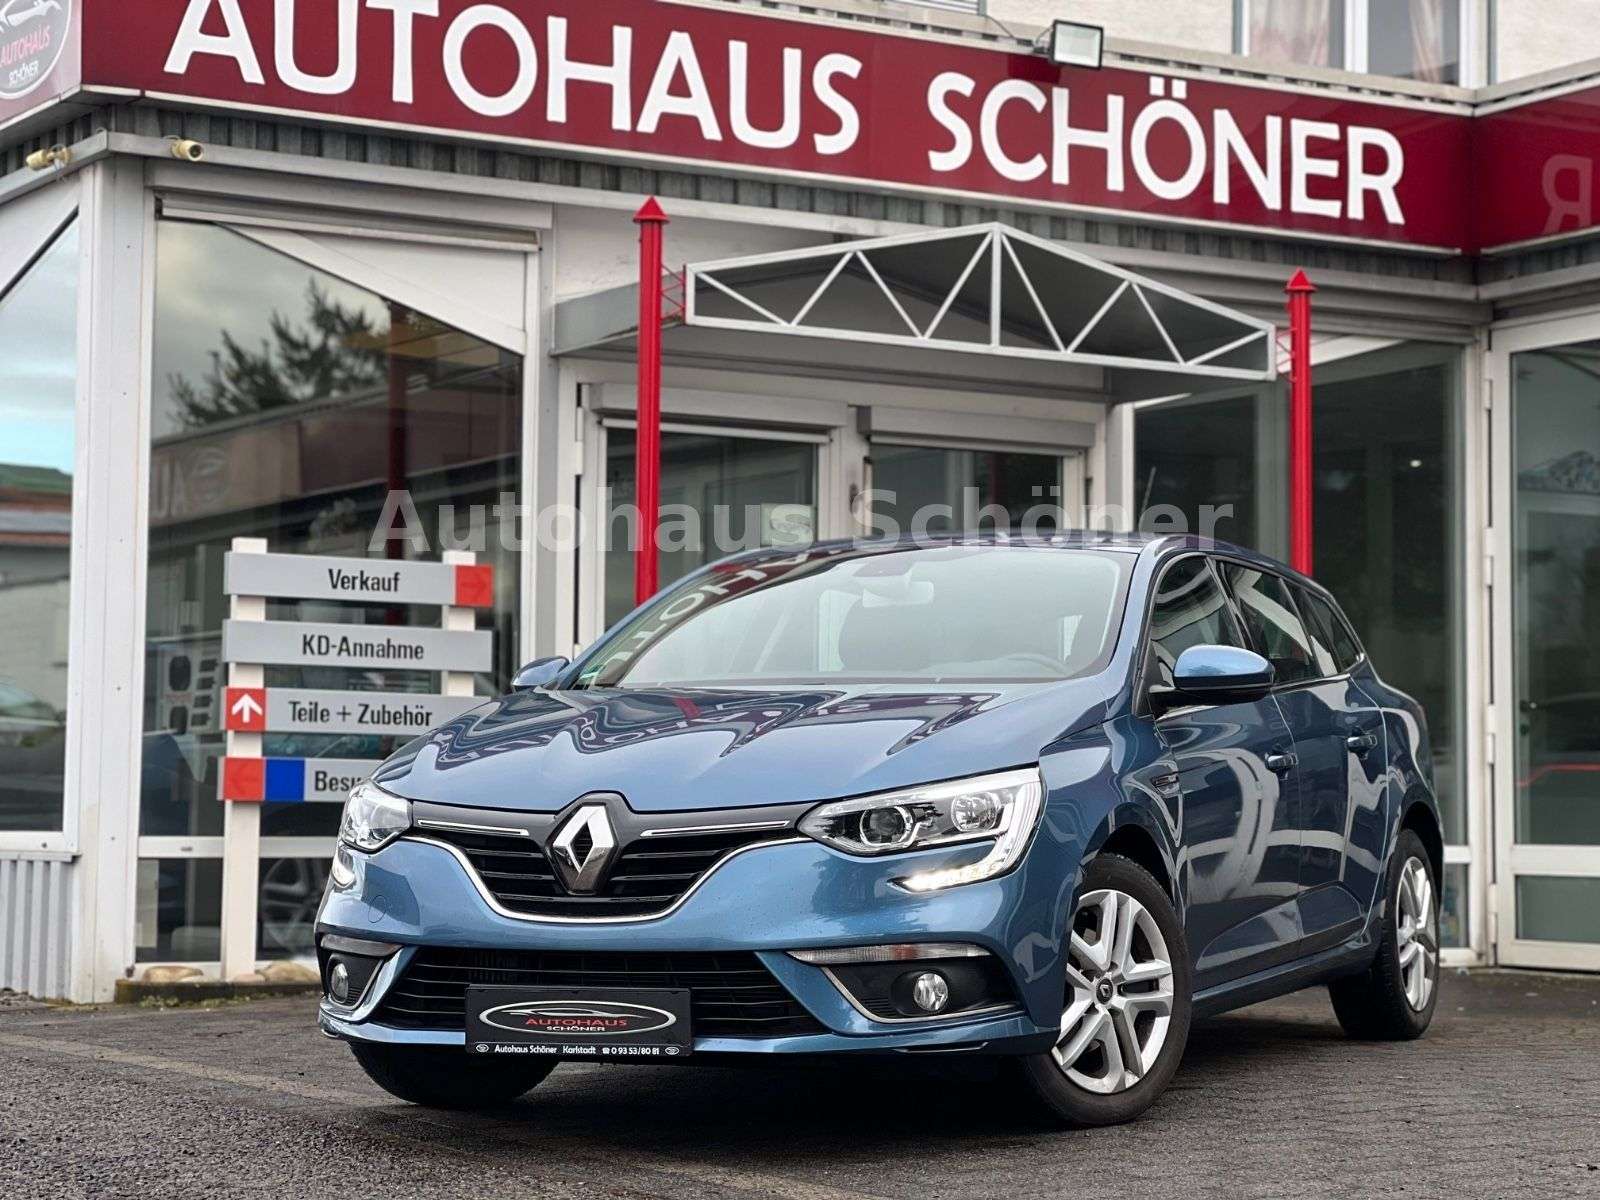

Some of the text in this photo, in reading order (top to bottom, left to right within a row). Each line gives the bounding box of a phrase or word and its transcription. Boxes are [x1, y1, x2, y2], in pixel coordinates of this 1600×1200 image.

[163, 0, 1405, 226] AUTOHAUS SCHÖNER
[328, 567, 401, 593] Verkauf
[302, 634, 424, 661] KD-Annahme
[288, 700, 330, 723] Teile
[358, 703, 433, 727] Zubehör
[525, 1017, 628, 1027] AUTOHAUS
[494, 1044, 529, 1054] Autohaus
[529, 1044, 557, 1054] Schöner
[562, 1045, 597, 1055] Karlstadt
[610, 1046, 617, 1055] 0
[618, 1046, 628, 1055] 93
